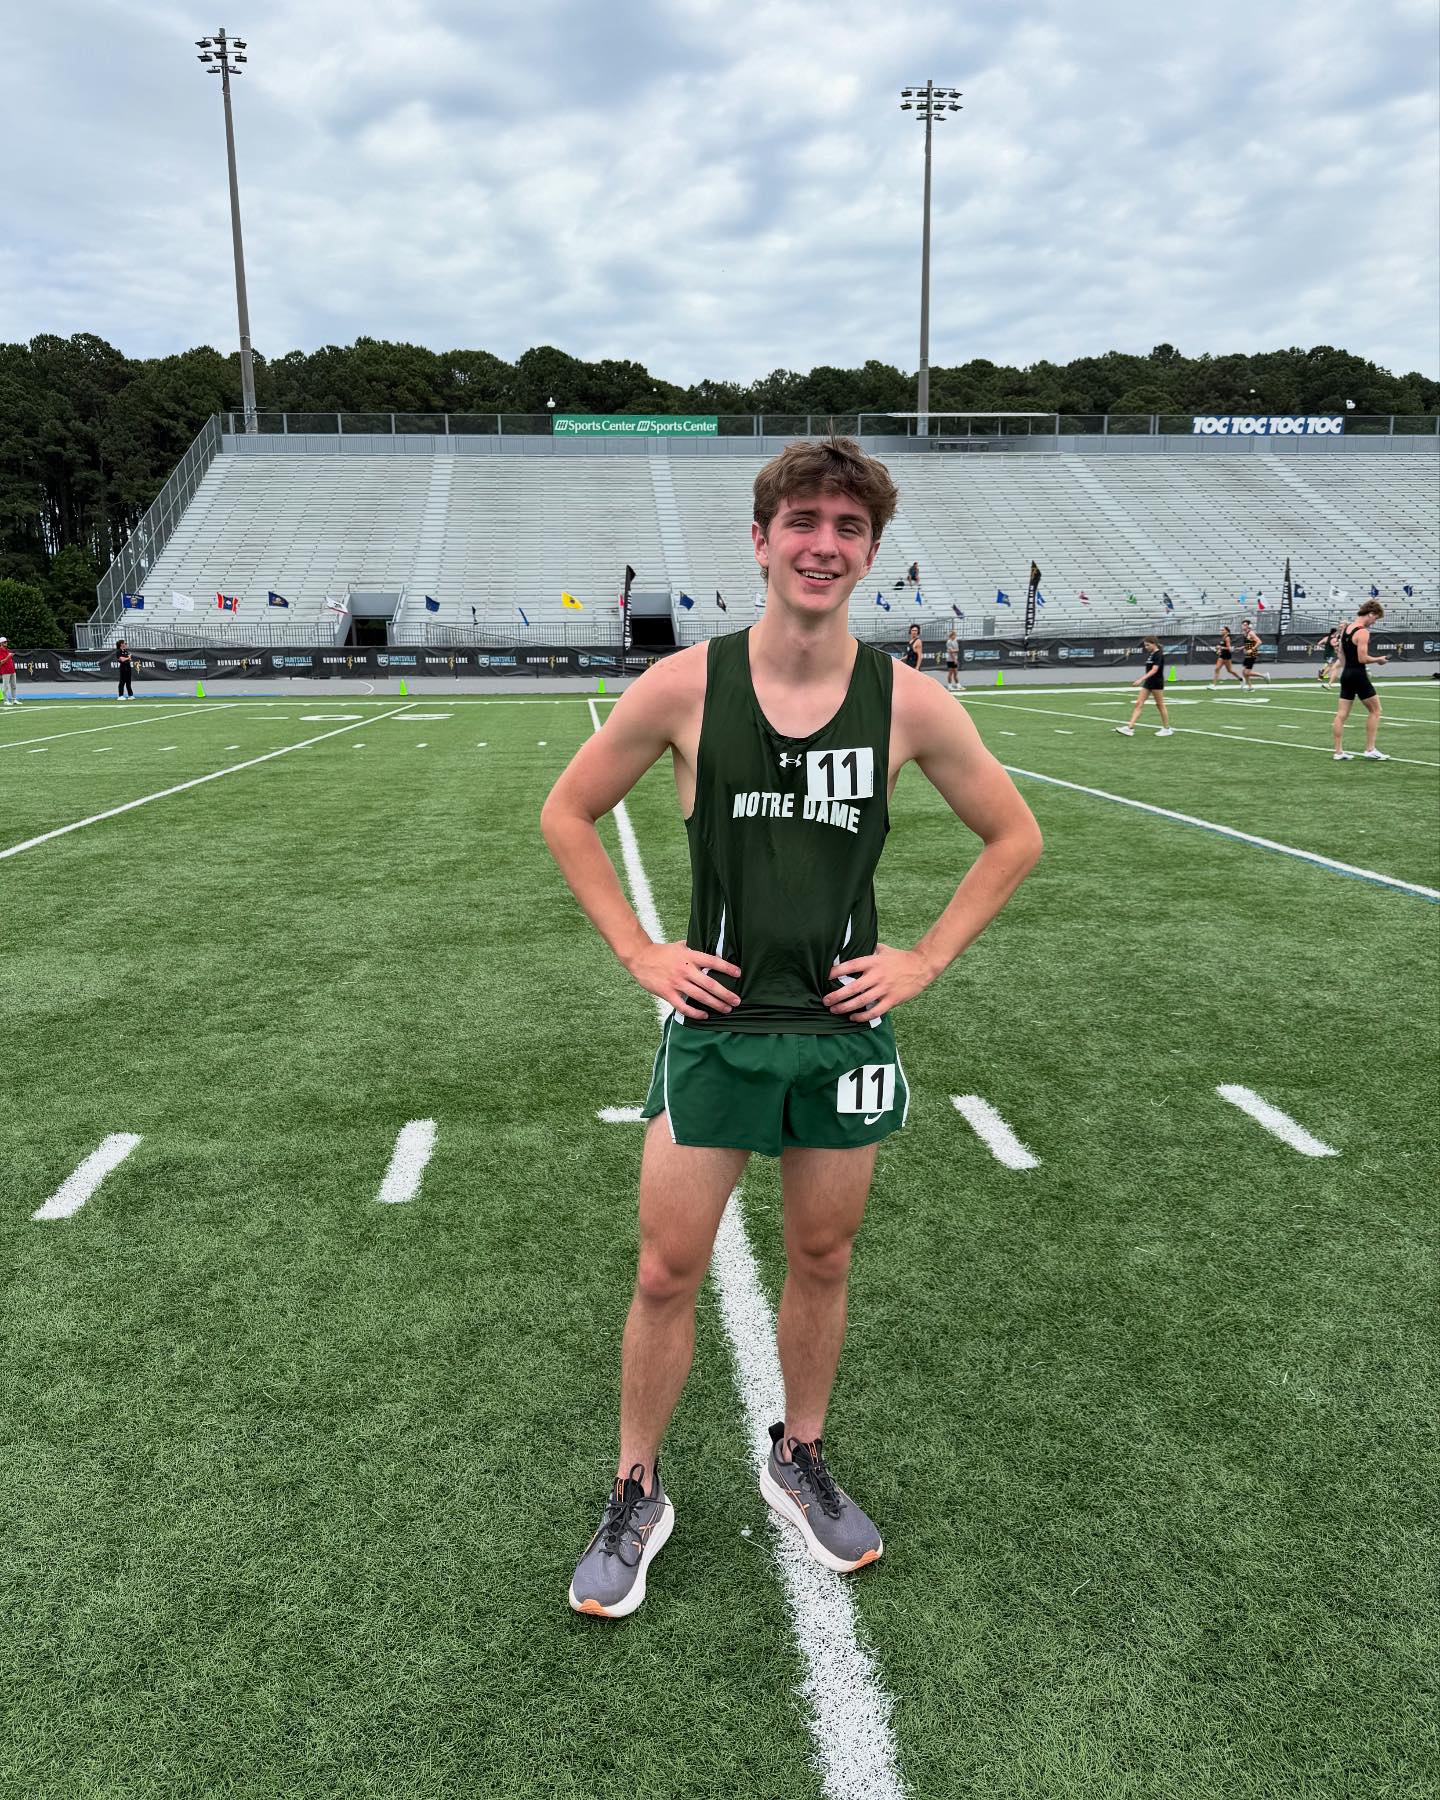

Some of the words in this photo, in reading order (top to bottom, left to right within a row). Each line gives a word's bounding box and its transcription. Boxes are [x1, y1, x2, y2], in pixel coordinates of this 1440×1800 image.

[568, 420, 601, 433] Sports
[601, 420, 636, 431] Center
[650, 420, 683, 434] Sports
[683, 421, 717, 432] Center
[1193, 417, 1230, 434] TOC
[1231, 417, 1268, 434] TOC
[1269, 417, 1305, 434] TOC
[1306, 417, 1343, 434] TOC
[818, 752, 858, 798] 11
[732, 791, 795, 819] NOTRE
[802, 795, 861, 834] DAME
[849, 1068, 884, 1110] 11
